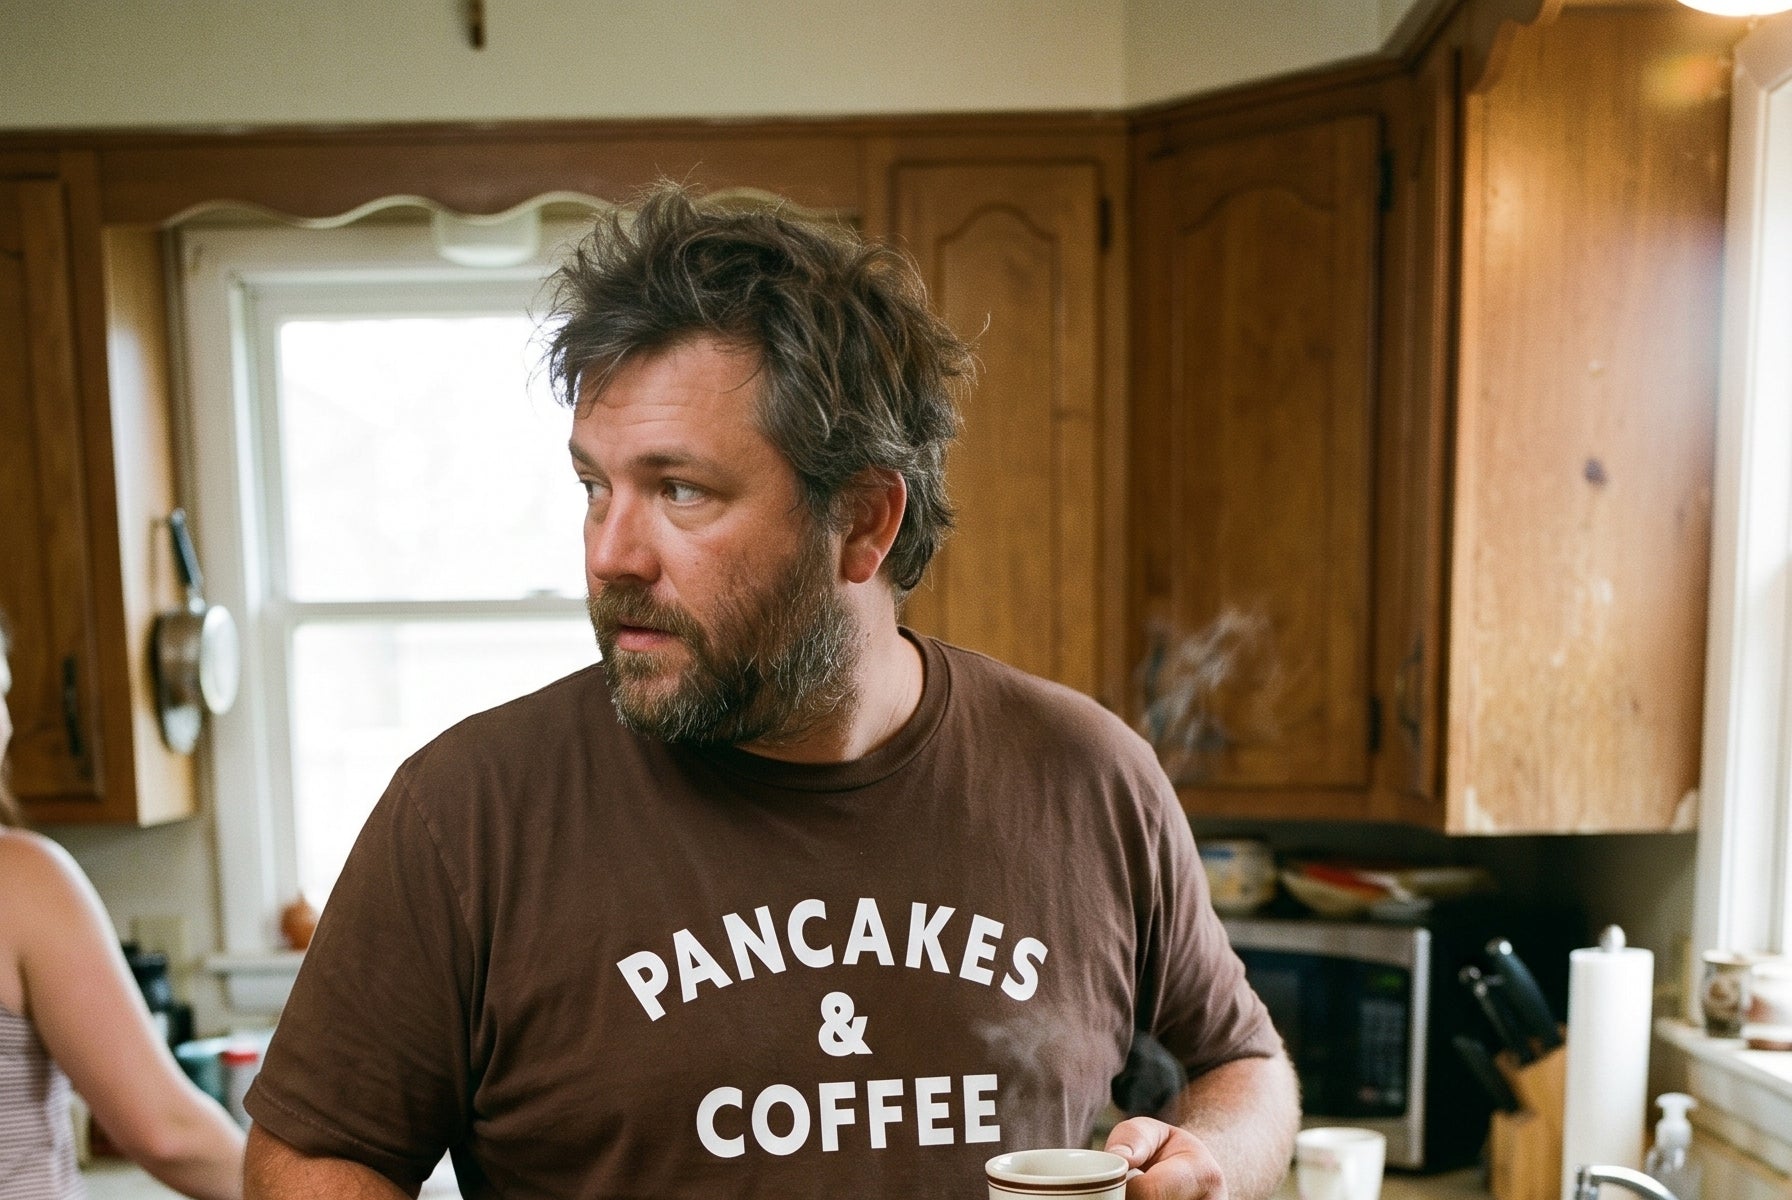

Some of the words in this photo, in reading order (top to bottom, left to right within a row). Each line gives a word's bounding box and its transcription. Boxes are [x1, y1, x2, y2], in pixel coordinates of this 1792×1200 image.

[616, 897, 1049, 1022] PANCAKES
[818, 991, 873, 1057] &
[696, 1073, 1001, 1158] COFFEE
